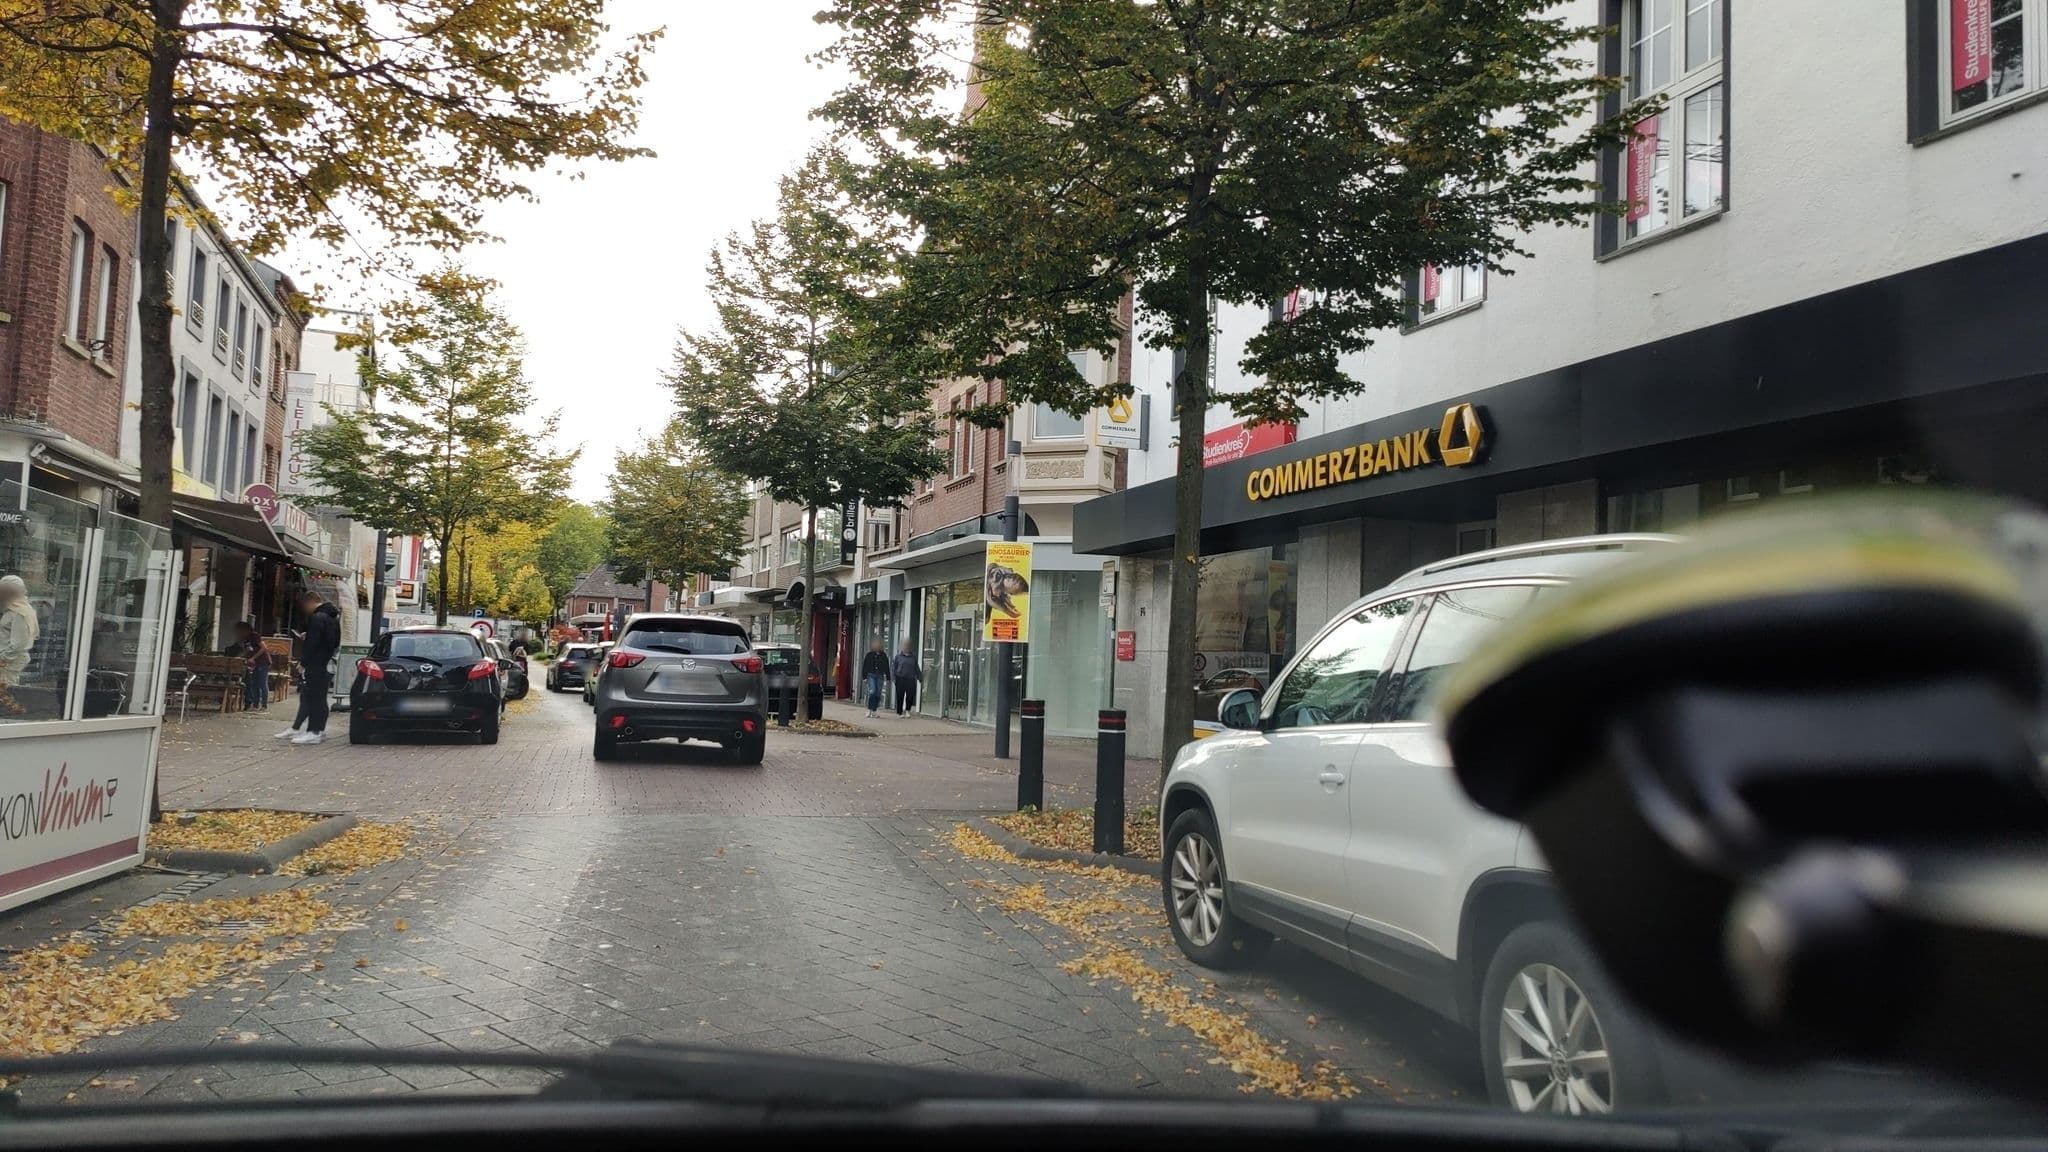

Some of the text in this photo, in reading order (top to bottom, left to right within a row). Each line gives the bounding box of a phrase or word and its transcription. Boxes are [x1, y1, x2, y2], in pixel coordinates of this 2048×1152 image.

[1965, 0, 1979, 79] Studienkre
[1634, 143, 1645, 214] Sudienkreis
[1246, 427, 1432, 501] COMMERZBANK
[243, 495, 279, 507] ROXY
[474, 609, 483, 618] P
